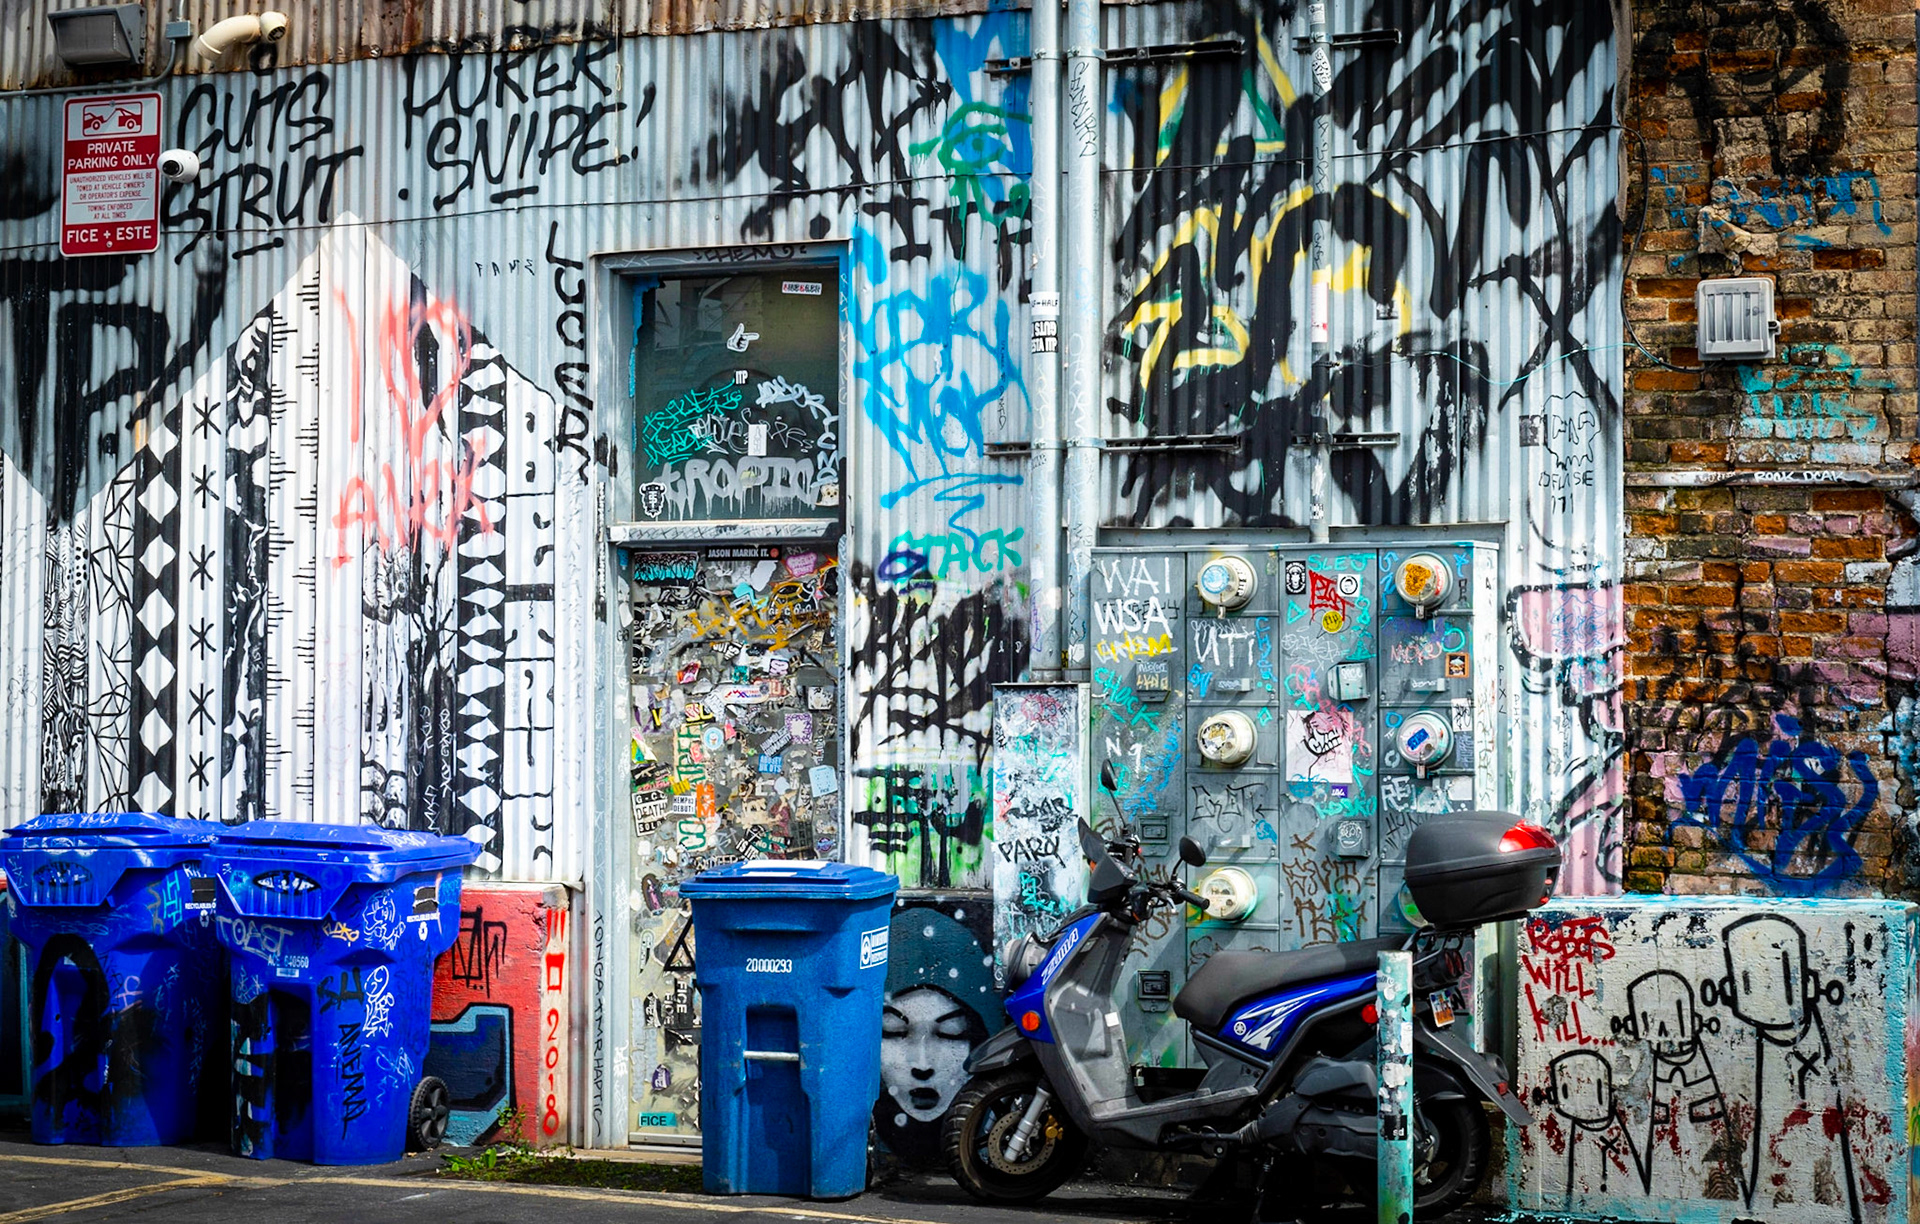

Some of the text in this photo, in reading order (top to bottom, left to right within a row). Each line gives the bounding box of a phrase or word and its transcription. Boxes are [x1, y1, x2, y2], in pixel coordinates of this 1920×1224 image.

[87, 140, 135, 154] PRIVATE
[68, 153, 155, 170] PARKING ONLY
[70, 174, 106, 184] UNAUTHORIZED
[108, 173, 131, 182] VEHICLES
[133, 172, 145, 180] WILL
[76, 181, 145, 192] TOWED AT VEHICLE OWNER'S
[79, 190, 142, 201] OR OPERATOR'S EXPENSE
[87, 202, 133, 212] TOWING ENFORCED
[93, 210, 127, 220] AT ALL TIMES
[67, 228, 99, 243] FICE
[116, 226, 152, 241] ESTE
[707, 549, 730, 558] JASON
[732, 548, 759, 558] MARKK
[1093, 596, 1173, 639] WSA
[1526, 917, 1616, 963] ROBOTS
[745, 957, 793, 973] 20000293
[1521, 954, 1594, 997] WILL
[640, 1115, 667, 1128] FICE
